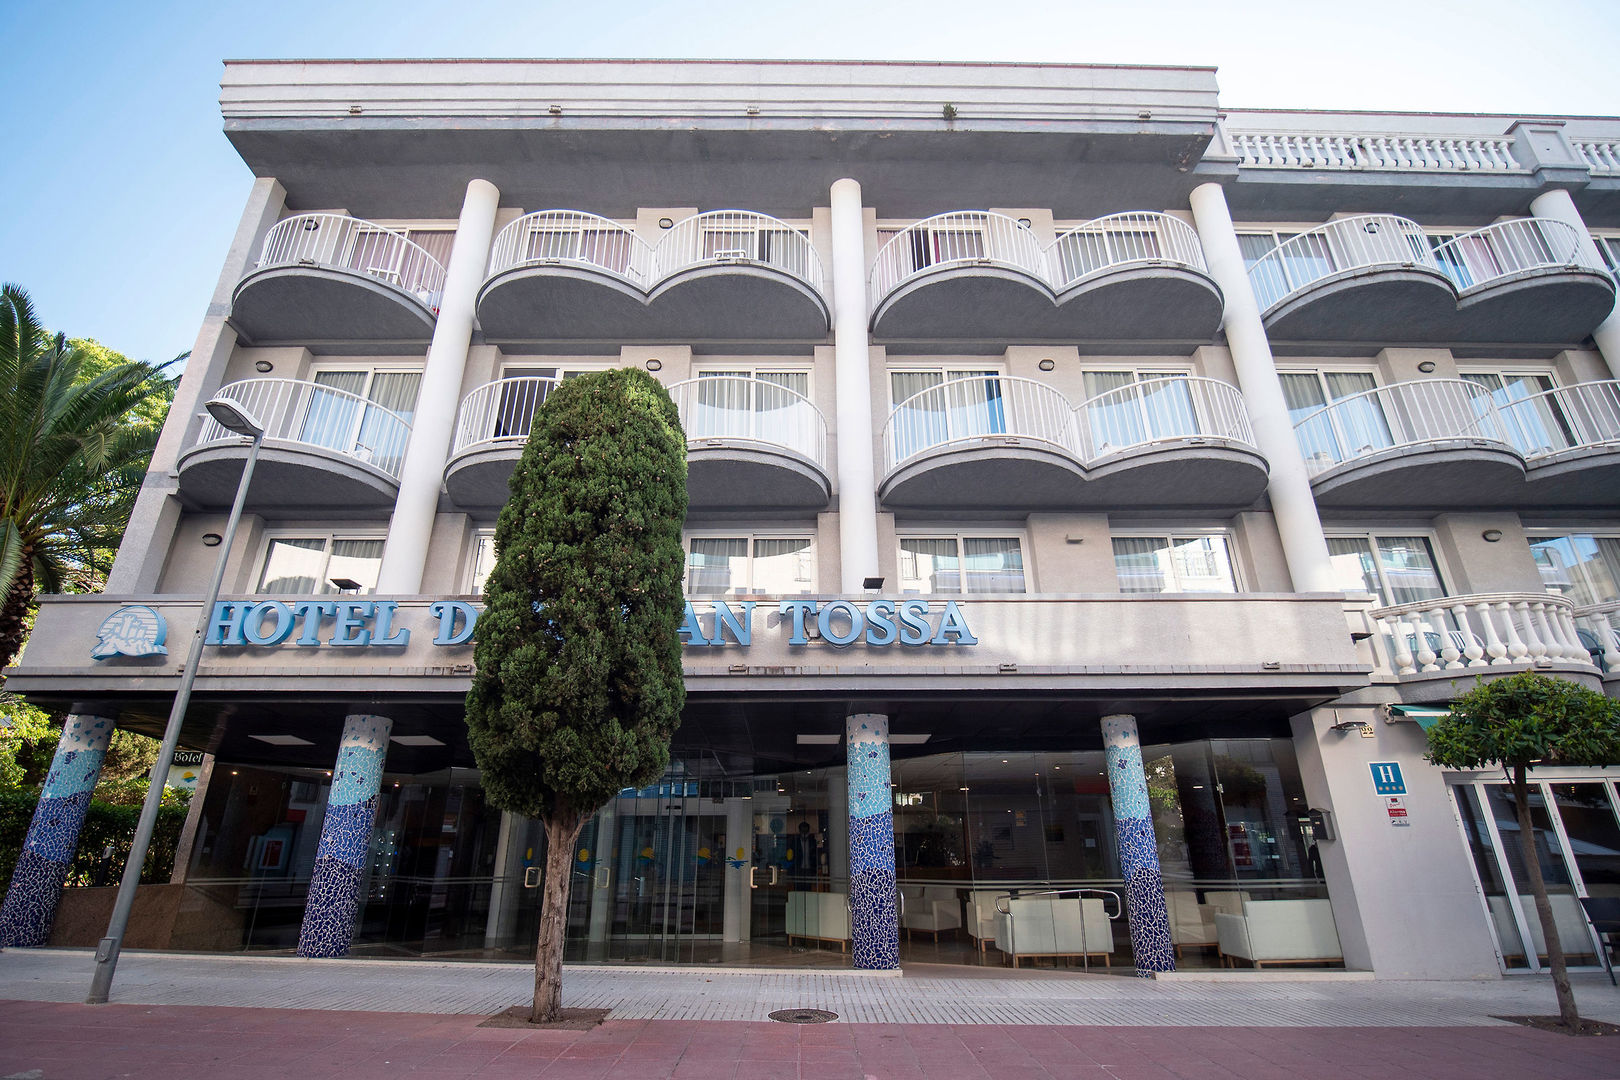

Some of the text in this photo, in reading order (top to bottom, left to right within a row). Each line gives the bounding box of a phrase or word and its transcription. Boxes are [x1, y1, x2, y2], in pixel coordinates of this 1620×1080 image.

[204, 600, 411, 647] HOTEL
[779, 600, 978, 647] TOSSA
[1378, 765, 1396, 783] H
